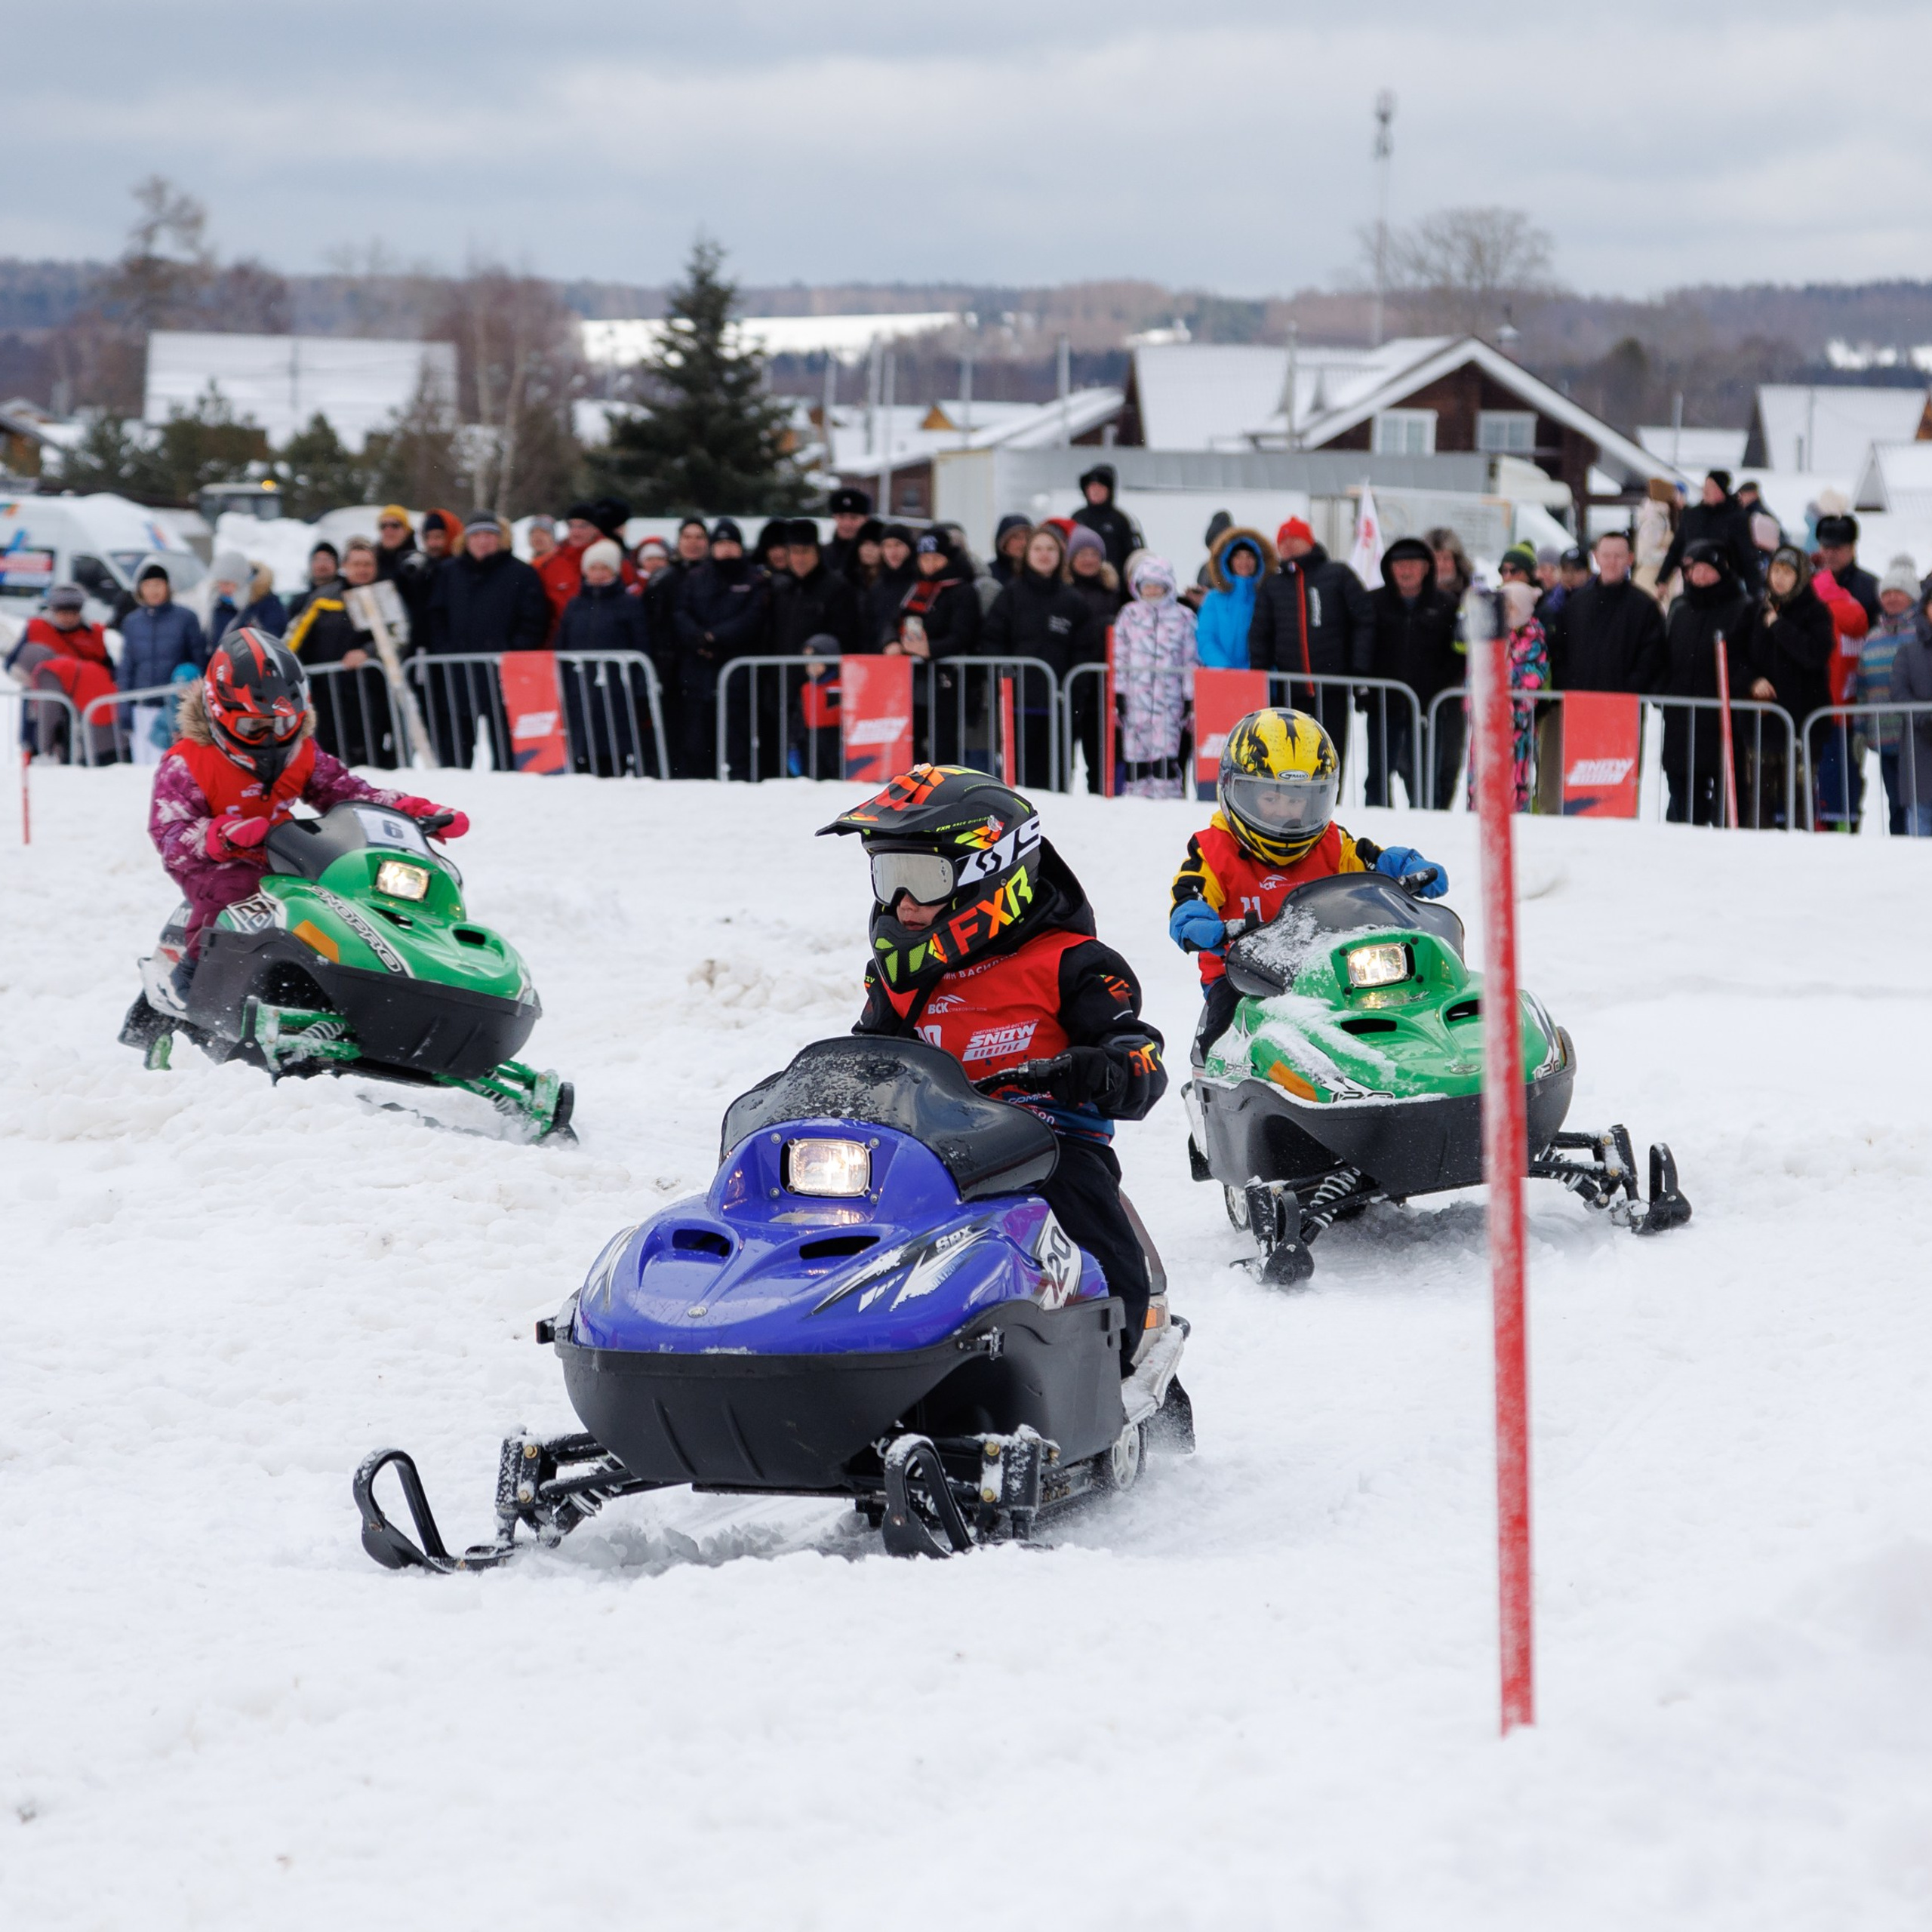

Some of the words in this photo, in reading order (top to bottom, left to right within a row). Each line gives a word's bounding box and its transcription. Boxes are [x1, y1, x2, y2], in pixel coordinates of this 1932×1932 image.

[382, 819, 405, 839] 6
[936, 824, 952, 832] FXR
[948, 865, 1033, 956] FXR
[927, 1001, 949, 1015] ВСК
[967, 1023, 1038, 1049] SNOW
[936, 1225, 974, 1255] SRX
